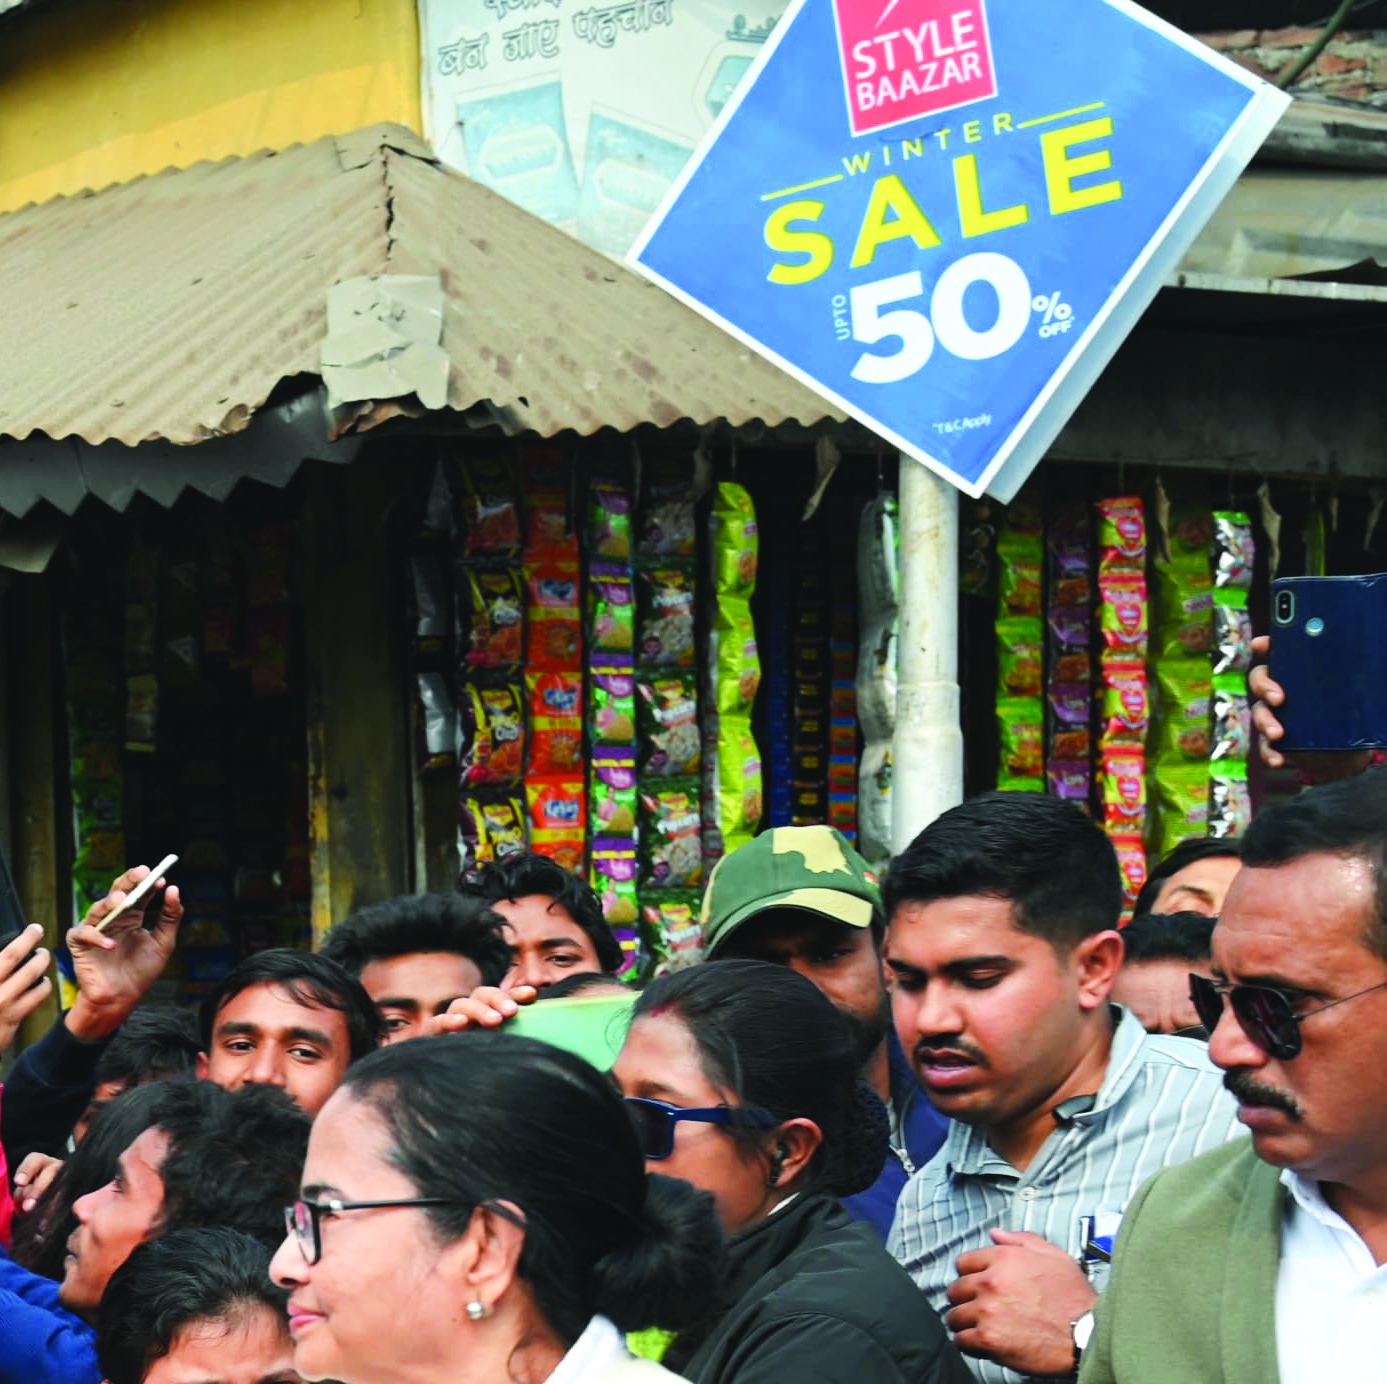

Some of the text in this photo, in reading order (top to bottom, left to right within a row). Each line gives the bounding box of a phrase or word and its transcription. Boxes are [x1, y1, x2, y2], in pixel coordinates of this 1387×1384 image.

[852, 9, 979, 80] STYLE
[856, 51, 983, 112] BAAZAR
[841, 111, 1015, 177] WINTER
[763, 116, 1124, 285] SALE
[831, 294, 851, 341] UPTO
